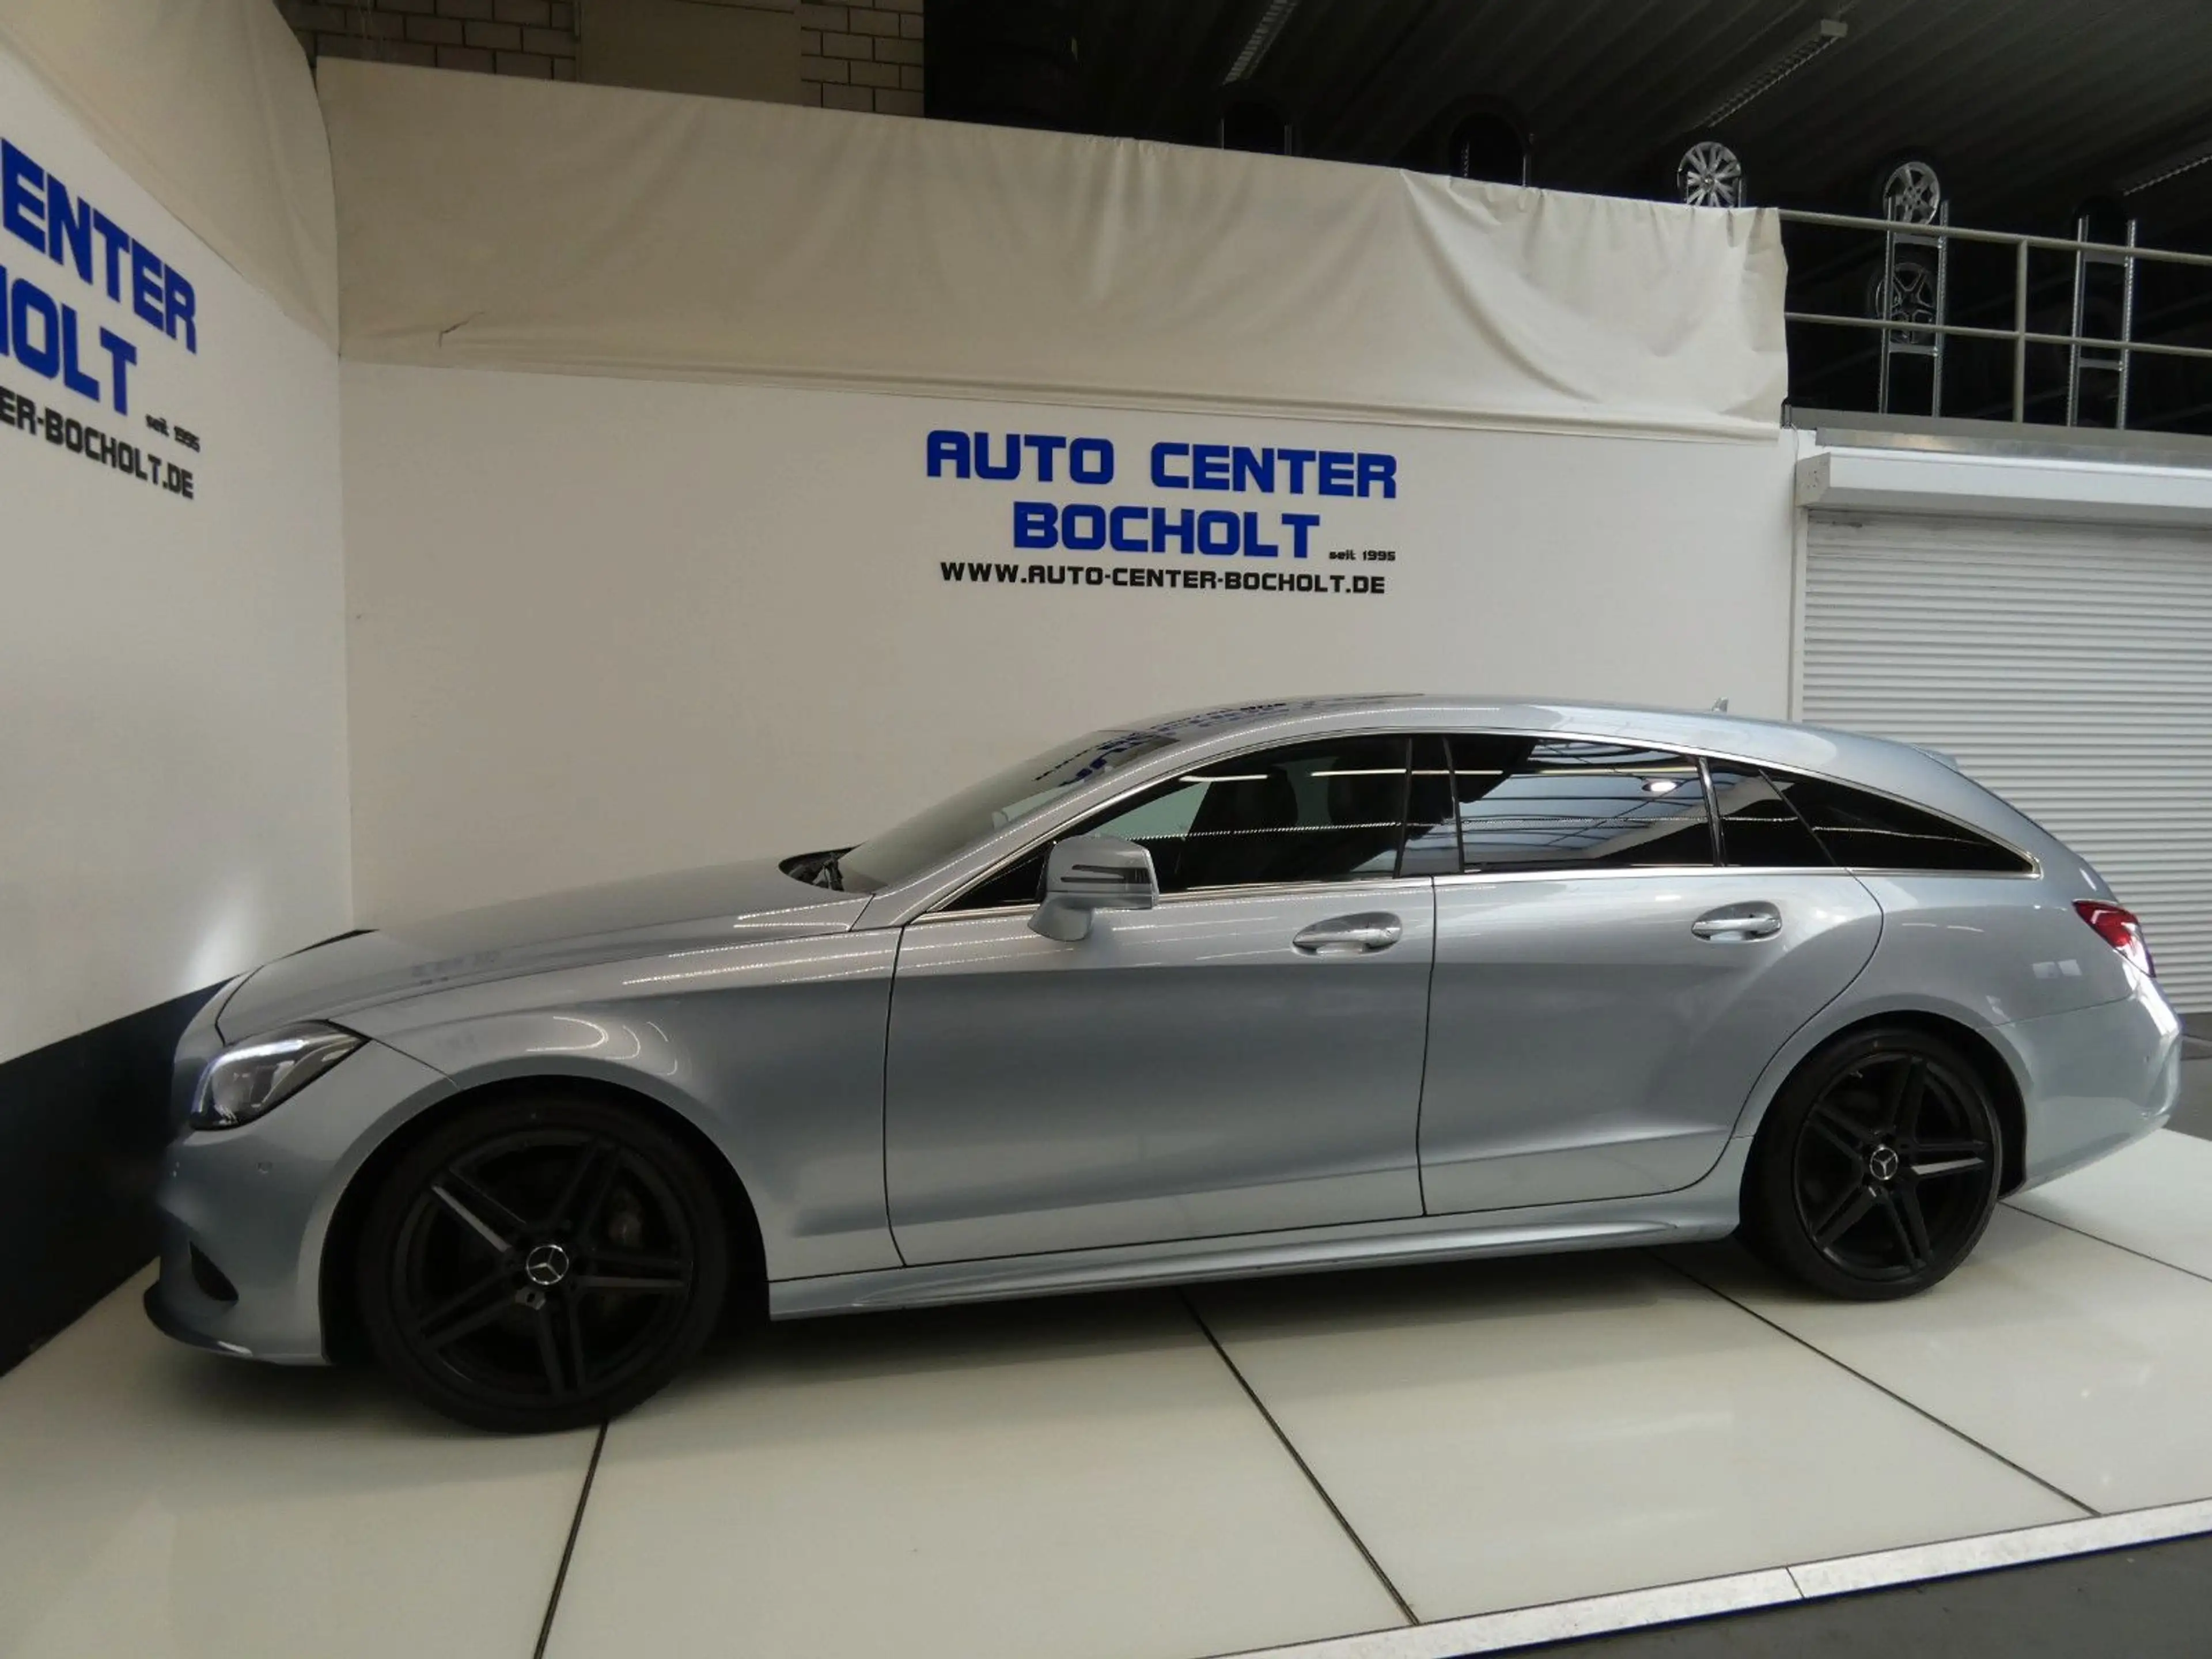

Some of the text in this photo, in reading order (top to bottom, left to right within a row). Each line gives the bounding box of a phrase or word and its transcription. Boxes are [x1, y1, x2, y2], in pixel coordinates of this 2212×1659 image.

[0, 264, 137, 416] OLT
[927, 430, 1397, 499] AUTO CENTER
[1013, 501, 1396, 562] BOCHOLT seit 1995
[940, 562, 1385, 594] WWW.AUTO-CENTER-BOCHOLT.DE
